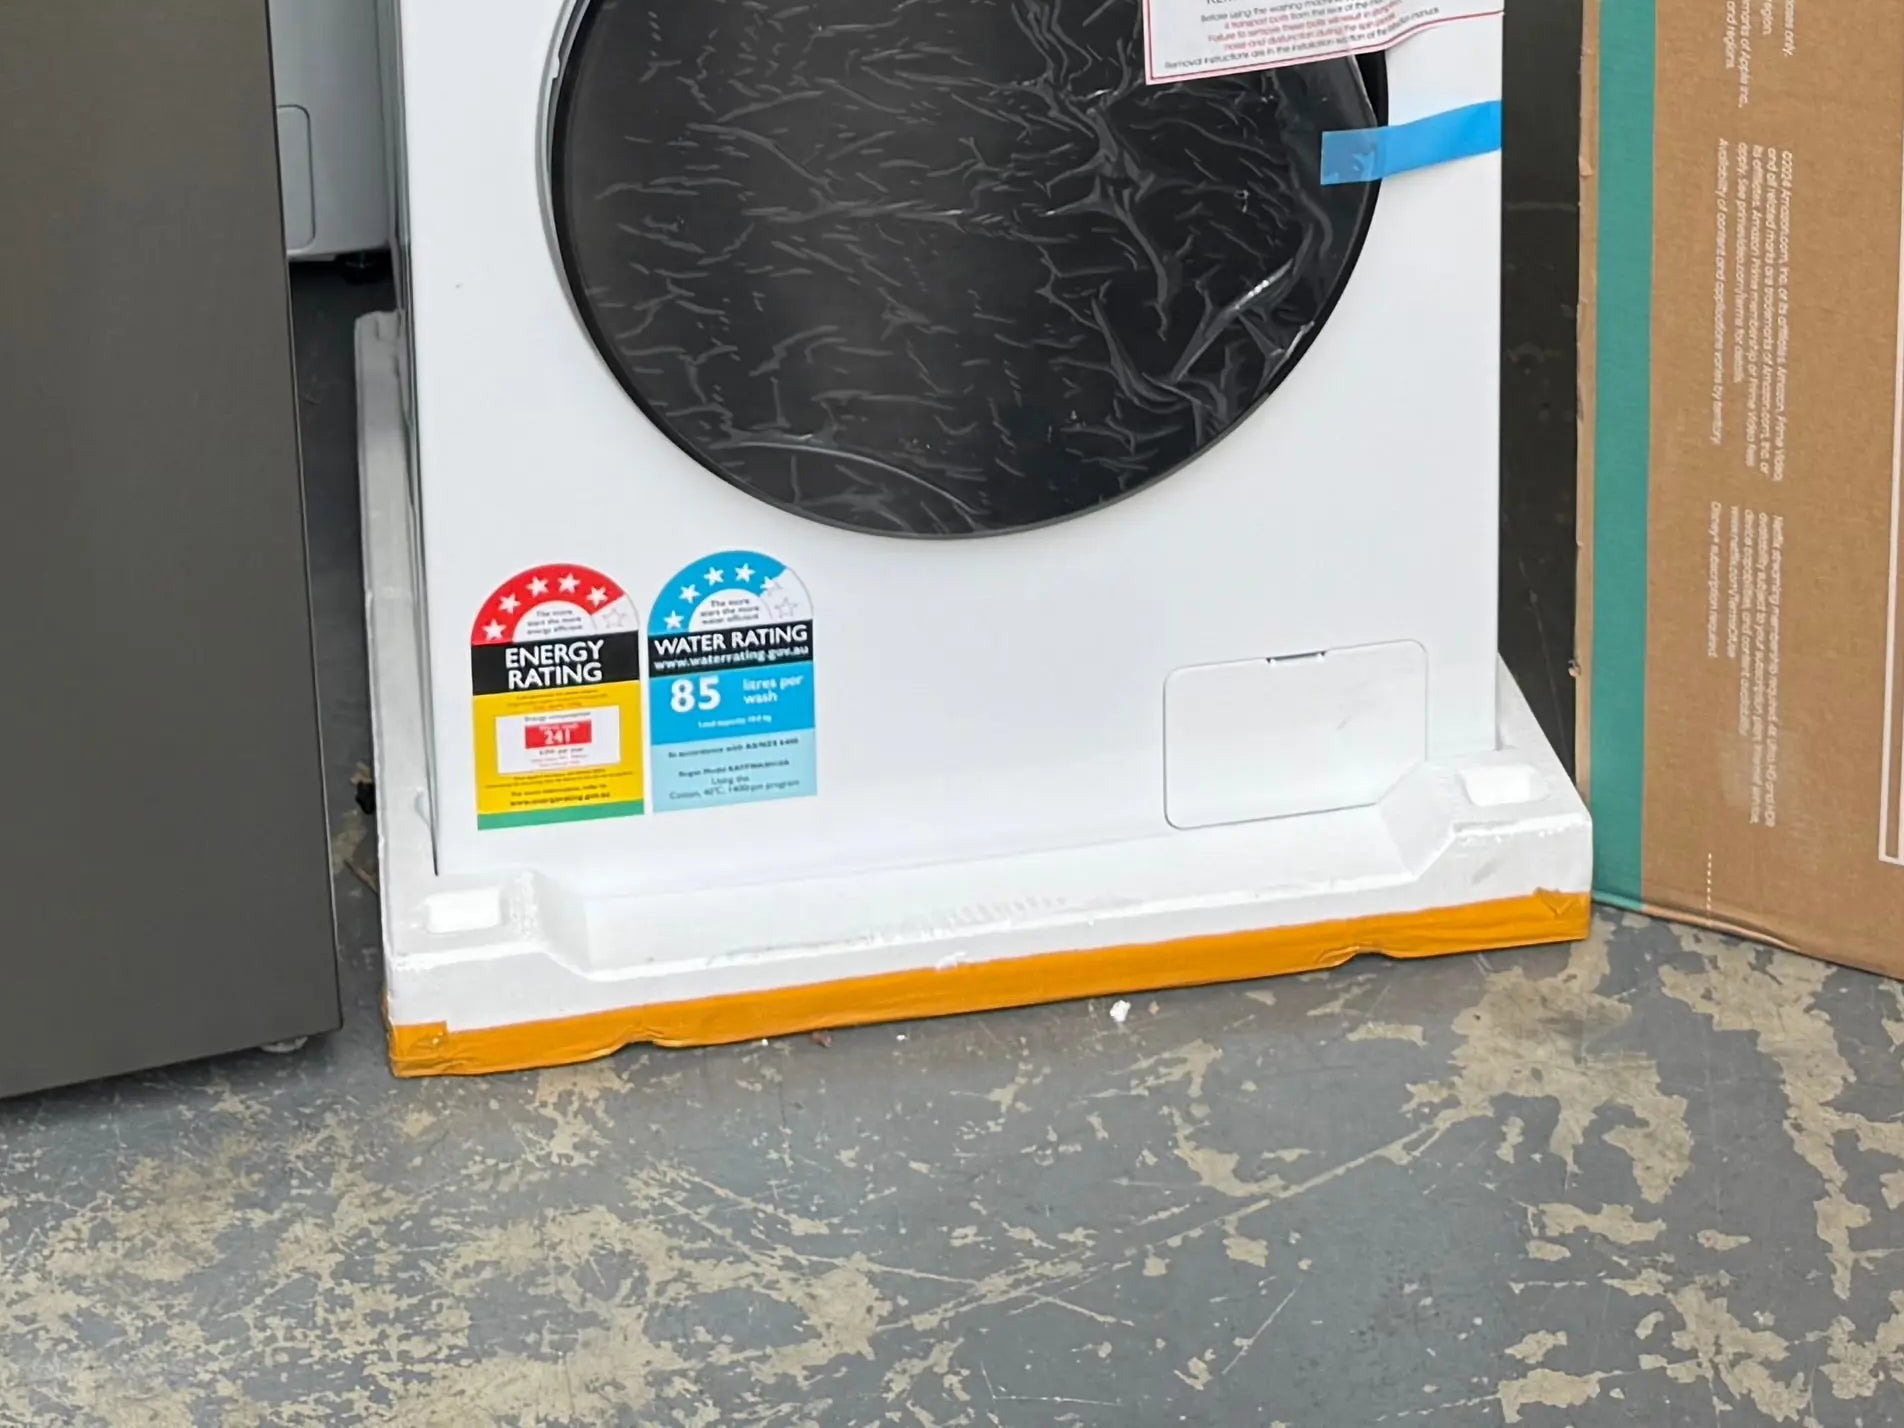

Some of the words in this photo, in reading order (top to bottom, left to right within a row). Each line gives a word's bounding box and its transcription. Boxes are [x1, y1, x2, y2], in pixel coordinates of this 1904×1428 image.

[505, 640, 604, 668] ENERGY
[654, 635, 726, 656] WATER
[731, 624, 809, 648] RATING
[508, 662, 603, 690] RATING
[742, 677, 777, 691] litres
[779, 675, 804, 690] per
[670, 674, 721, 713] 85
[744, 691, 778, 704] wash
